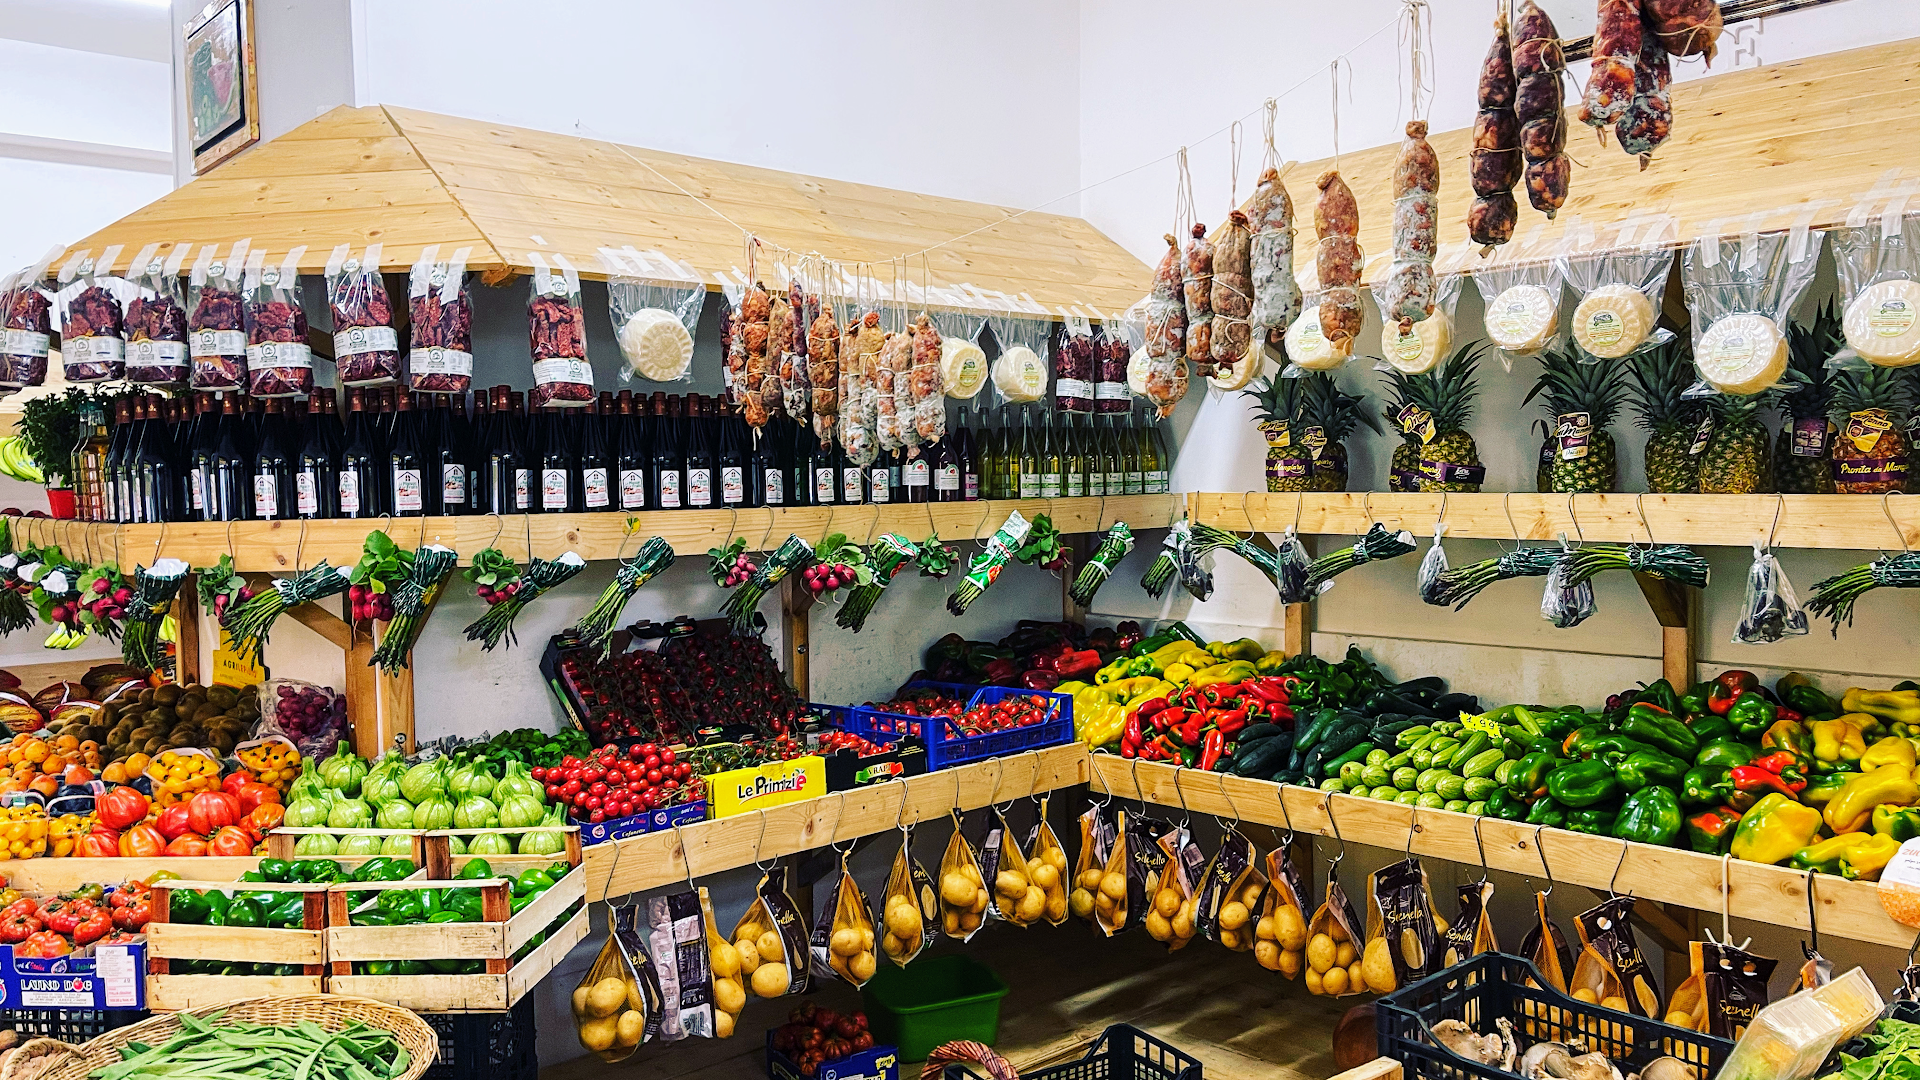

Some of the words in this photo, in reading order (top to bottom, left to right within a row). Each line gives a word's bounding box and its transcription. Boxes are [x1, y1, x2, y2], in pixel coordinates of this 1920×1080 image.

[1840, 462, 1872, 474] Pronta
[738, 784, 753, 799] Le
[755, 773, 807, 796] Primizie
[20, 979, 60, 991] LATINO
